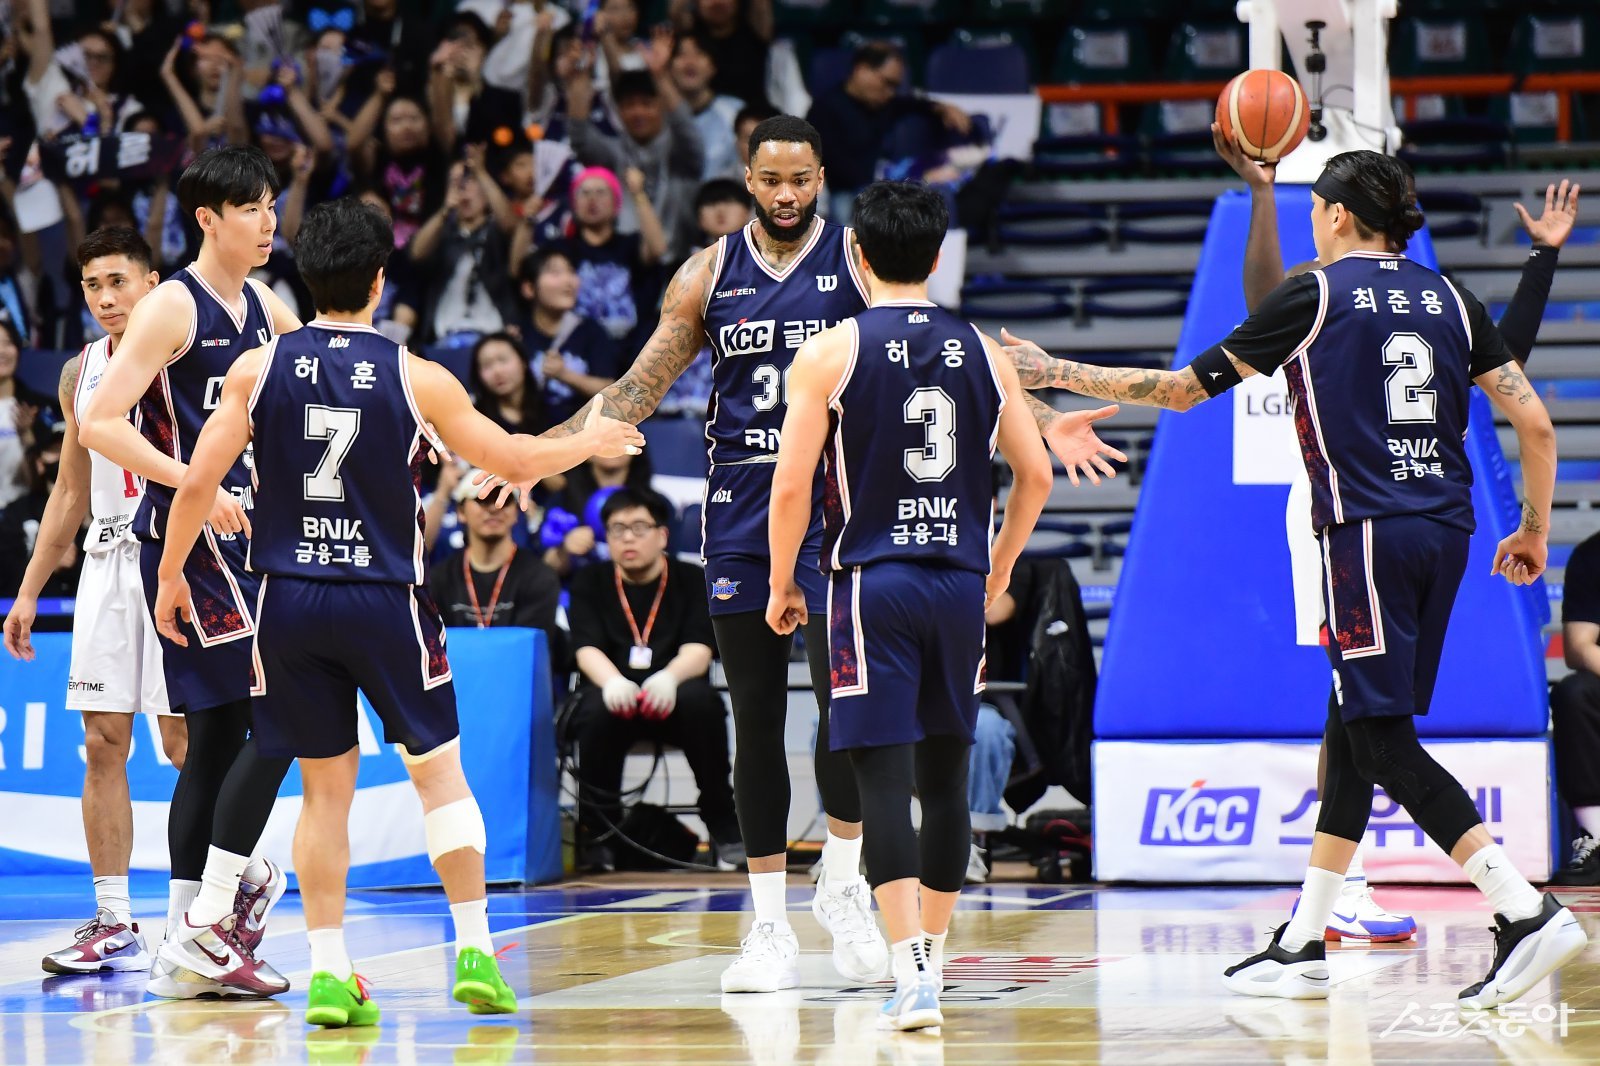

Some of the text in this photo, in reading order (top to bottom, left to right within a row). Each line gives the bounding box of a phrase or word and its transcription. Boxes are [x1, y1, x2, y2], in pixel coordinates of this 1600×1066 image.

[722, 318, 772, 355] KCC
[1381, 331, 1438, 425] 2
[903, 386, 957, 483] 3
[1386, 437, 1440, 459] BNK
[303, 403, 362, 502] 7
[897, 496, 958, 520] BNK
[302, 516, 365, 541] BNK
[890, 522, 959, 546] 금융그룹
[295, 541, 373, 568] 금융그룹
[1150, 780, 1250, 843] KCC
